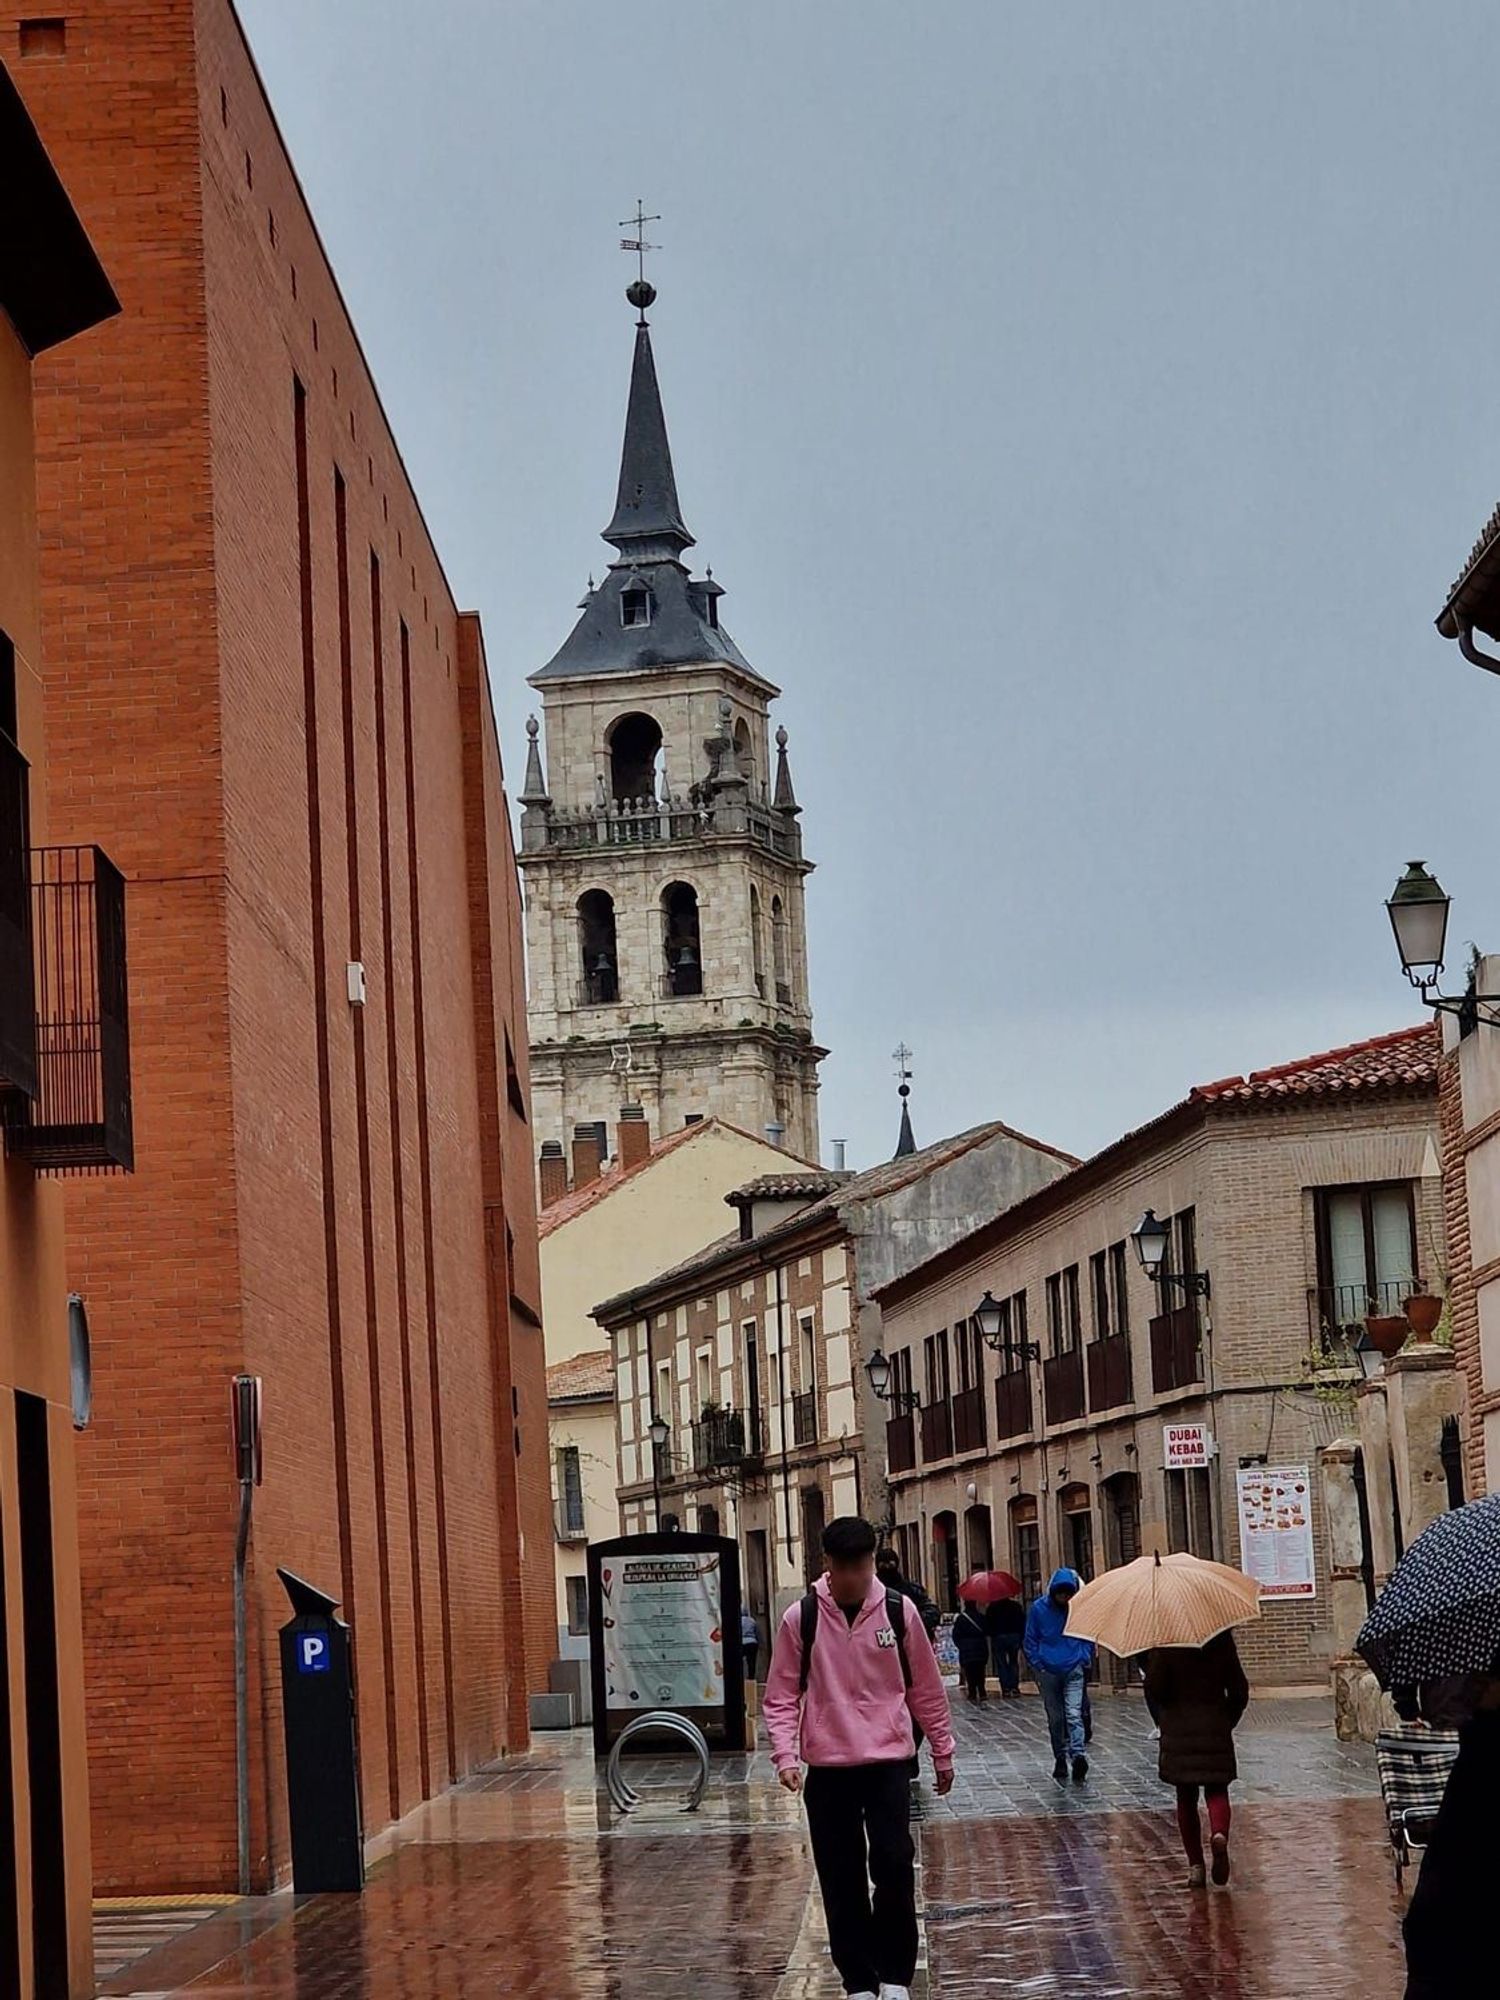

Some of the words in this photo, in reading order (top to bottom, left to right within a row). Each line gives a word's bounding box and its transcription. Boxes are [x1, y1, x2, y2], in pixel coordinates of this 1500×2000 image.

[1169, 1429, 1202, 1441] DUBAI
[1169, 1443, 1204, 1455] KEBAB
[303, 1638, 324, 1665] P
